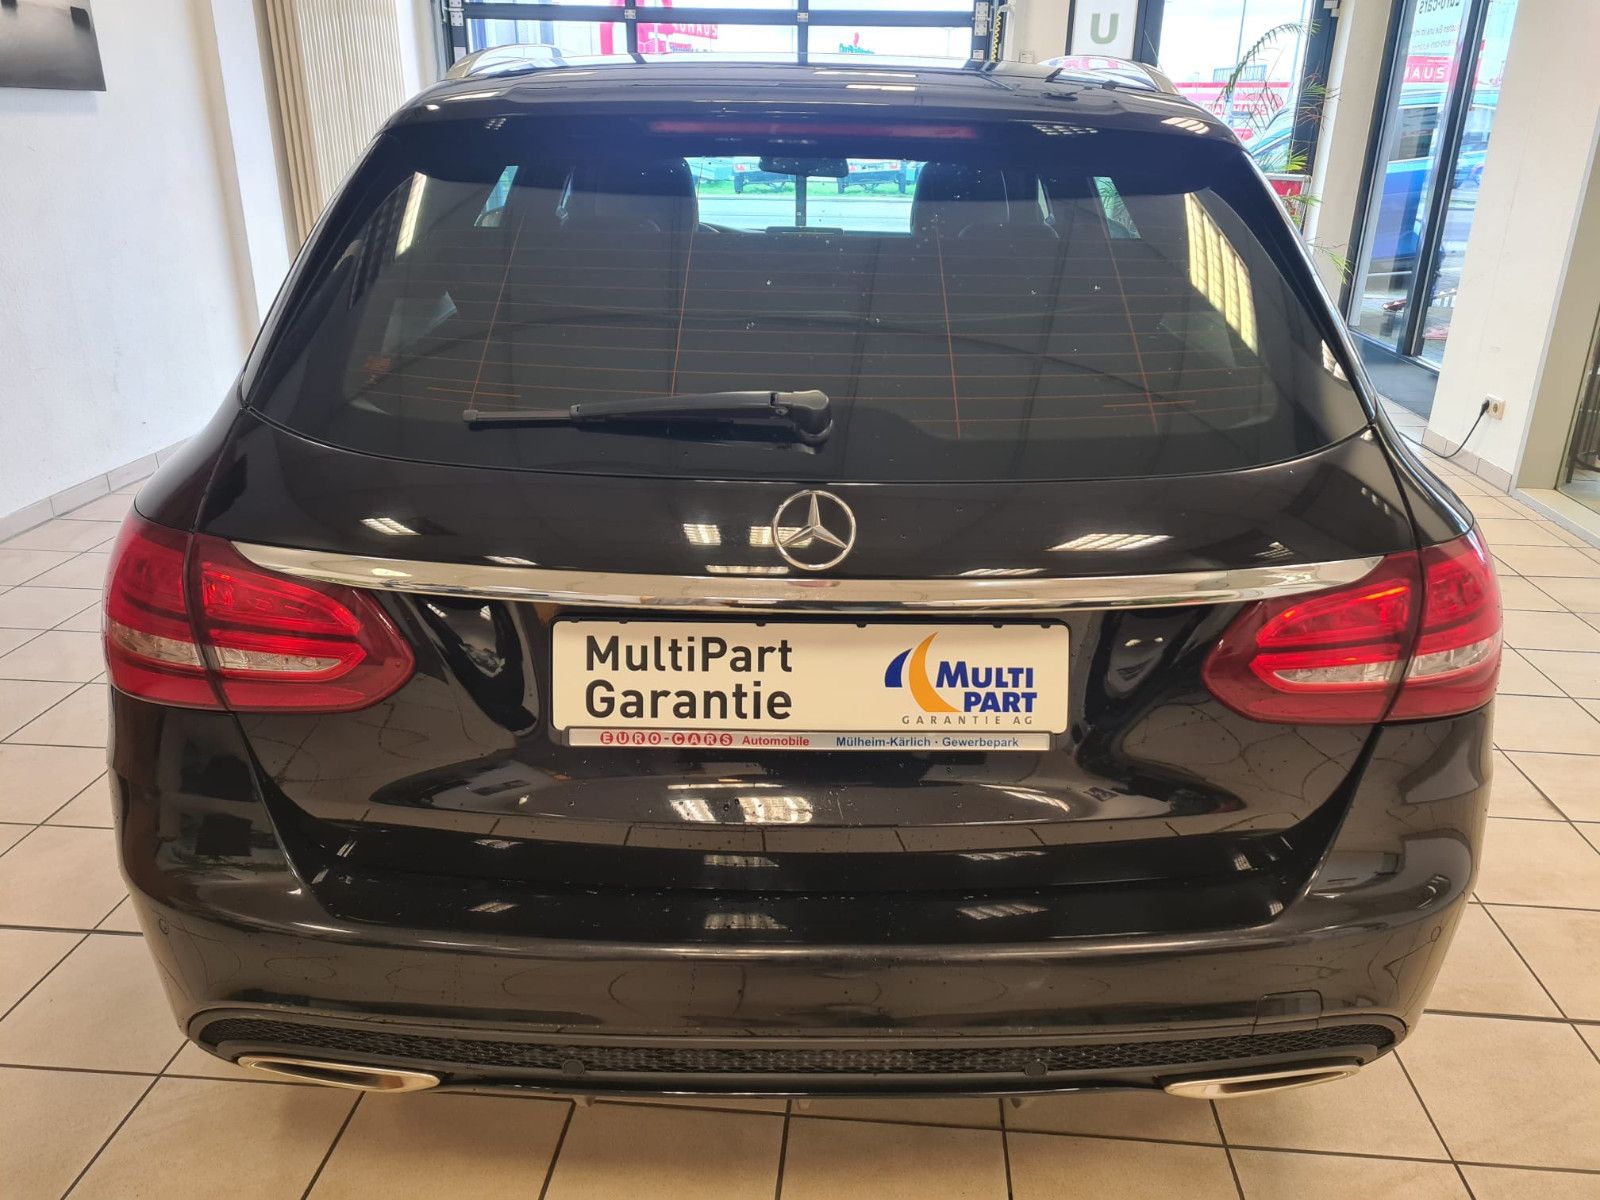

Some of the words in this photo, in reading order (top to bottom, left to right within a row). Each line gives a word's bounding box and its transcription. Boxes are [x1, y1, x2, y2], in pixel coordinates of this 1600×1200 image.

[1090, 13, 1119, 44] U
[586, 635, 793, 672] MultiPart
[935, 661, 1034, 688] MULTI
[585, 679, 792, 720] Garantie
[964, 692, 1037, 712] PART
[902, 715, 1001, 725] GARANTIE
[1013, 715, 1033, 725] AG
[600, 731, 733, 746] EURO-CARS
[742, 734, 810, 747] Automobile
[836, 736, 931, 748] Mülheim-Kärlich
[942, 737, 1019, 750] Gewerbepark
